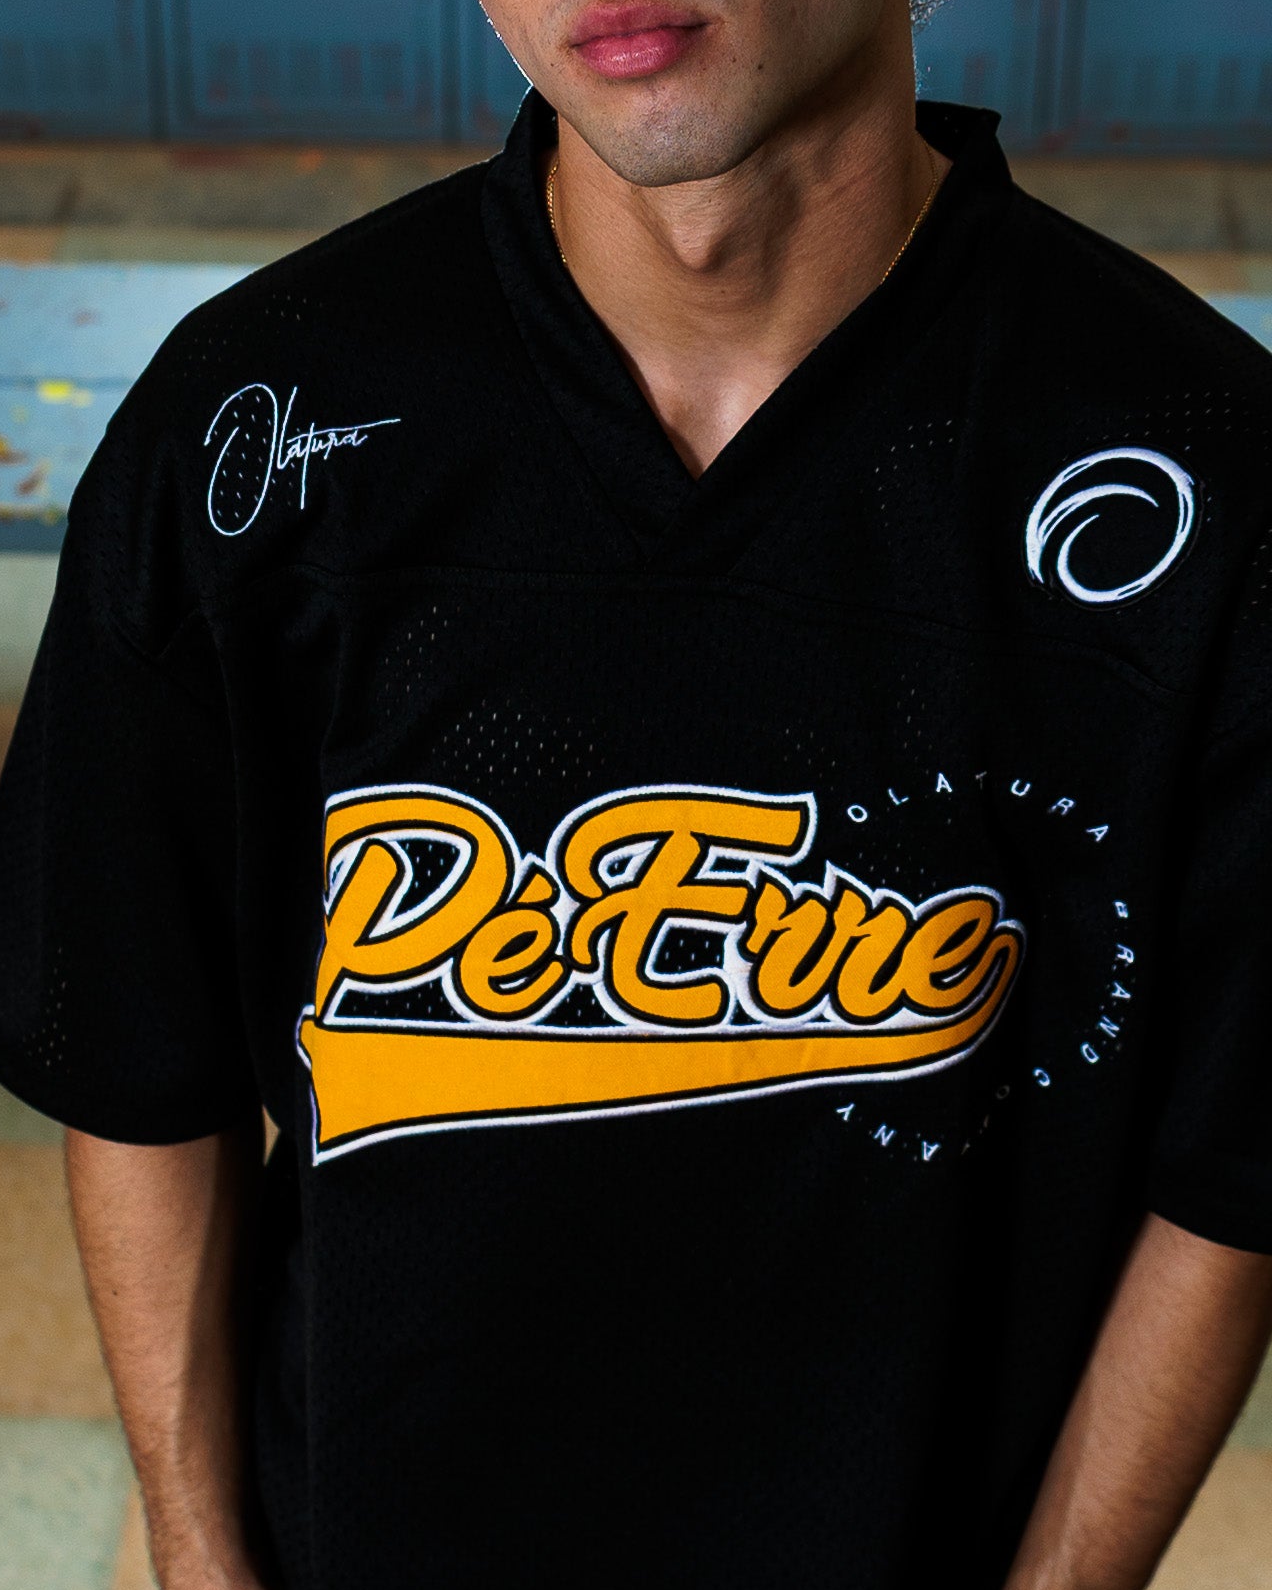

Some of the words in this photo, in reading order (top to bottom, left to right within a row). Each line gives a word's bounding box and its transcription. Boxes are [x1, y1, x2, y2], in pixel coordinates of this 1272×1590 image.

[204, 383, 401, 535] Olatura
[845, 770, 1111, 843] OLATURA
[1079, 899, 1137, 1066] BRAND
[832, 1065, 1053, 1163] COANY
